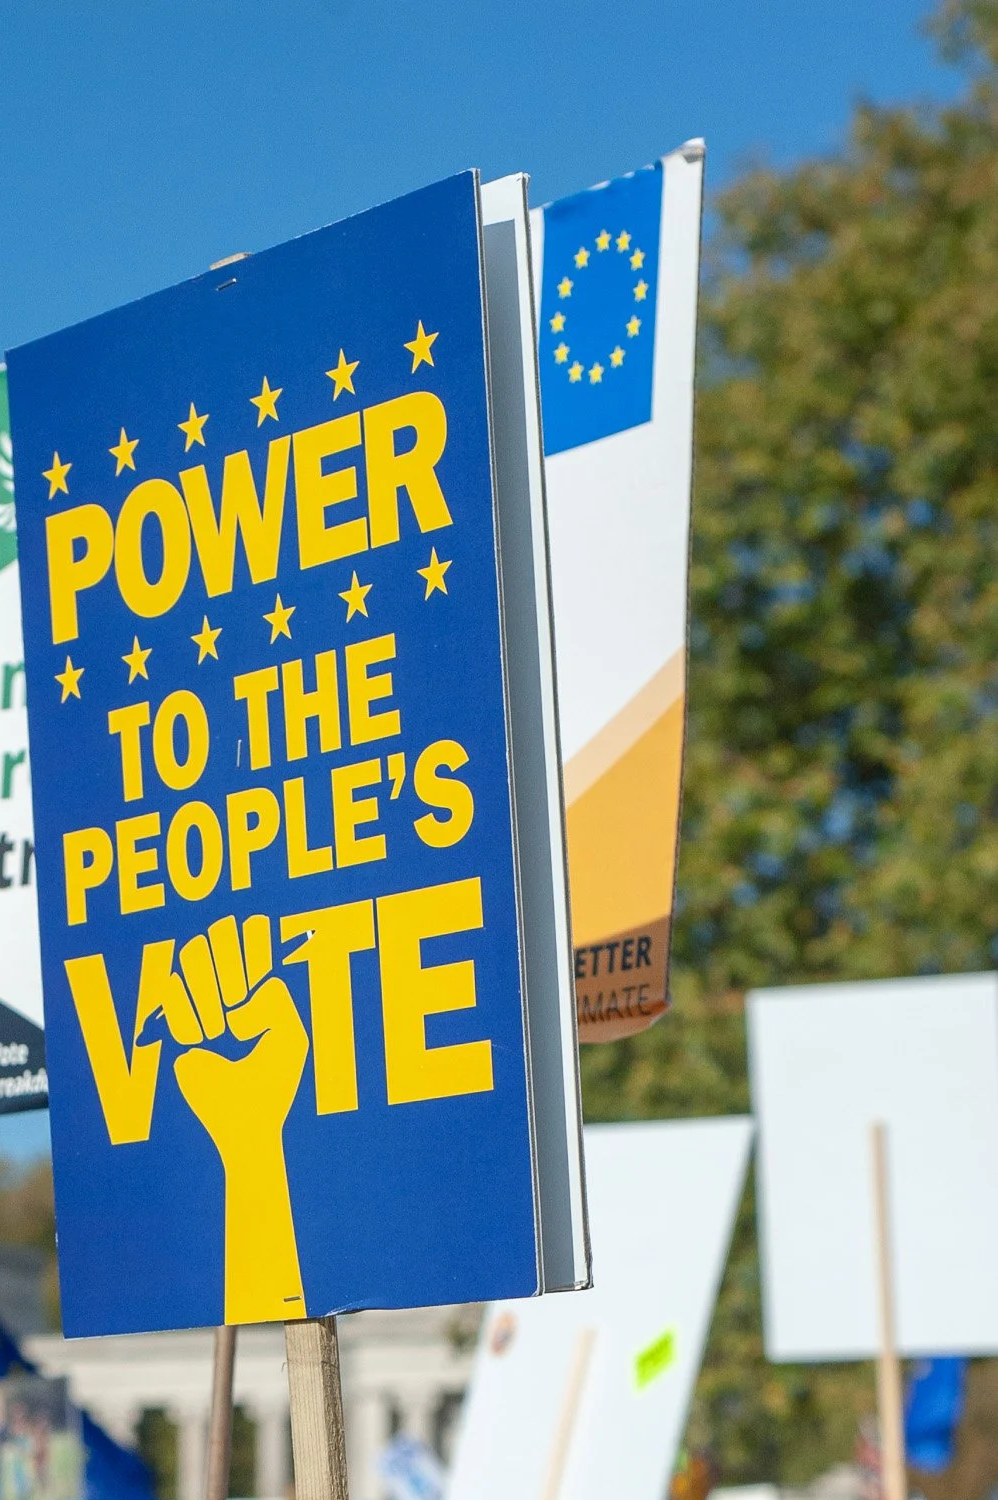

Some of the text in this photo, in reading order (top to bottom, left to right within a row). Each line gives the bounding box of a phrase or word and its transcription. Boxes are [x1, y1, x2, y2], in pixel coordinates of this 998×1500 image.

[45, 392, 452, 645] POWER
[107, 634, 401, 802] TO THE
[62, 739, 475, 926] PEOPLE'S
[576, 983, 652, 1025] MATE
